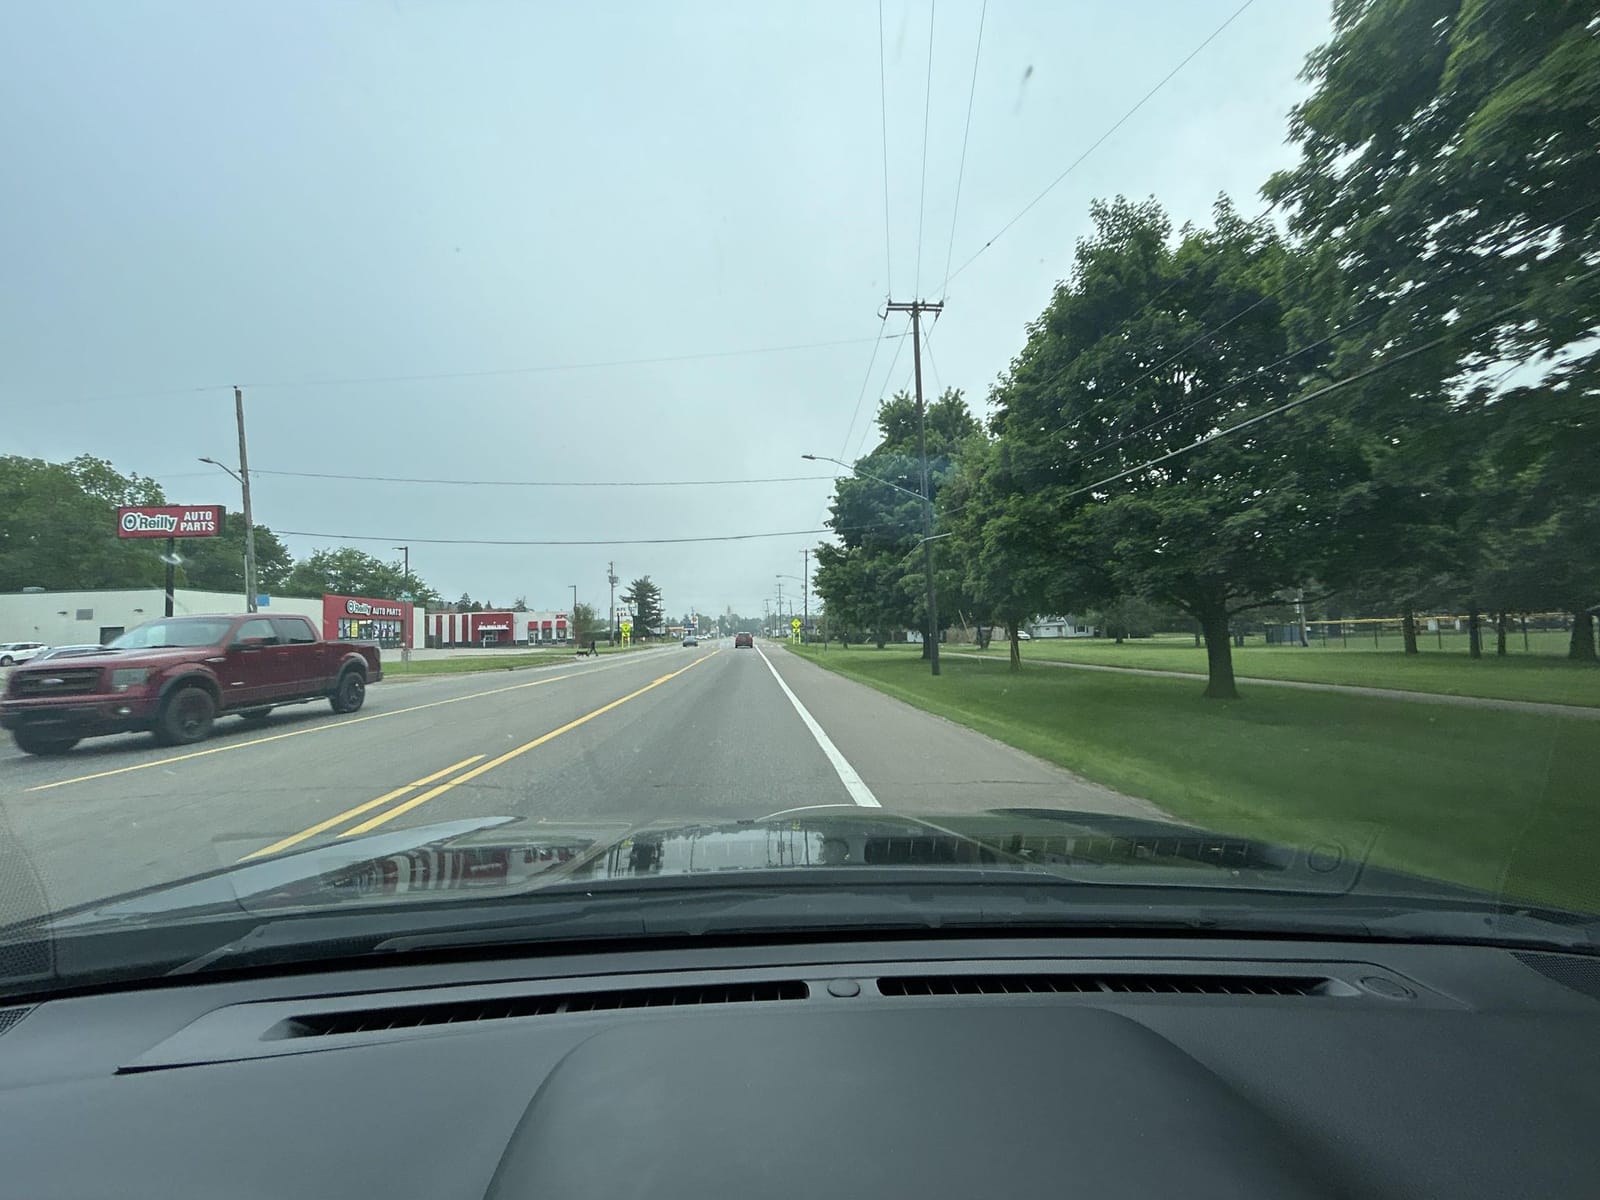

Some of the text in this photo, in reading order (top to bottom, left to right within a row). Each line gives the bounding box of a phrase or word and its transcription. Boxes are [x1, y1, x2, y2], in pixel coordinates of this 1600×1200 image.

[183, 511, 212, 521] AUTO
[123, 513, 177, 532] O'Reilly
[180, 522, 215, 532] PARTS
[372, 607, 386, 615] AUTO
[386, 608, 402, 616] PARTS
